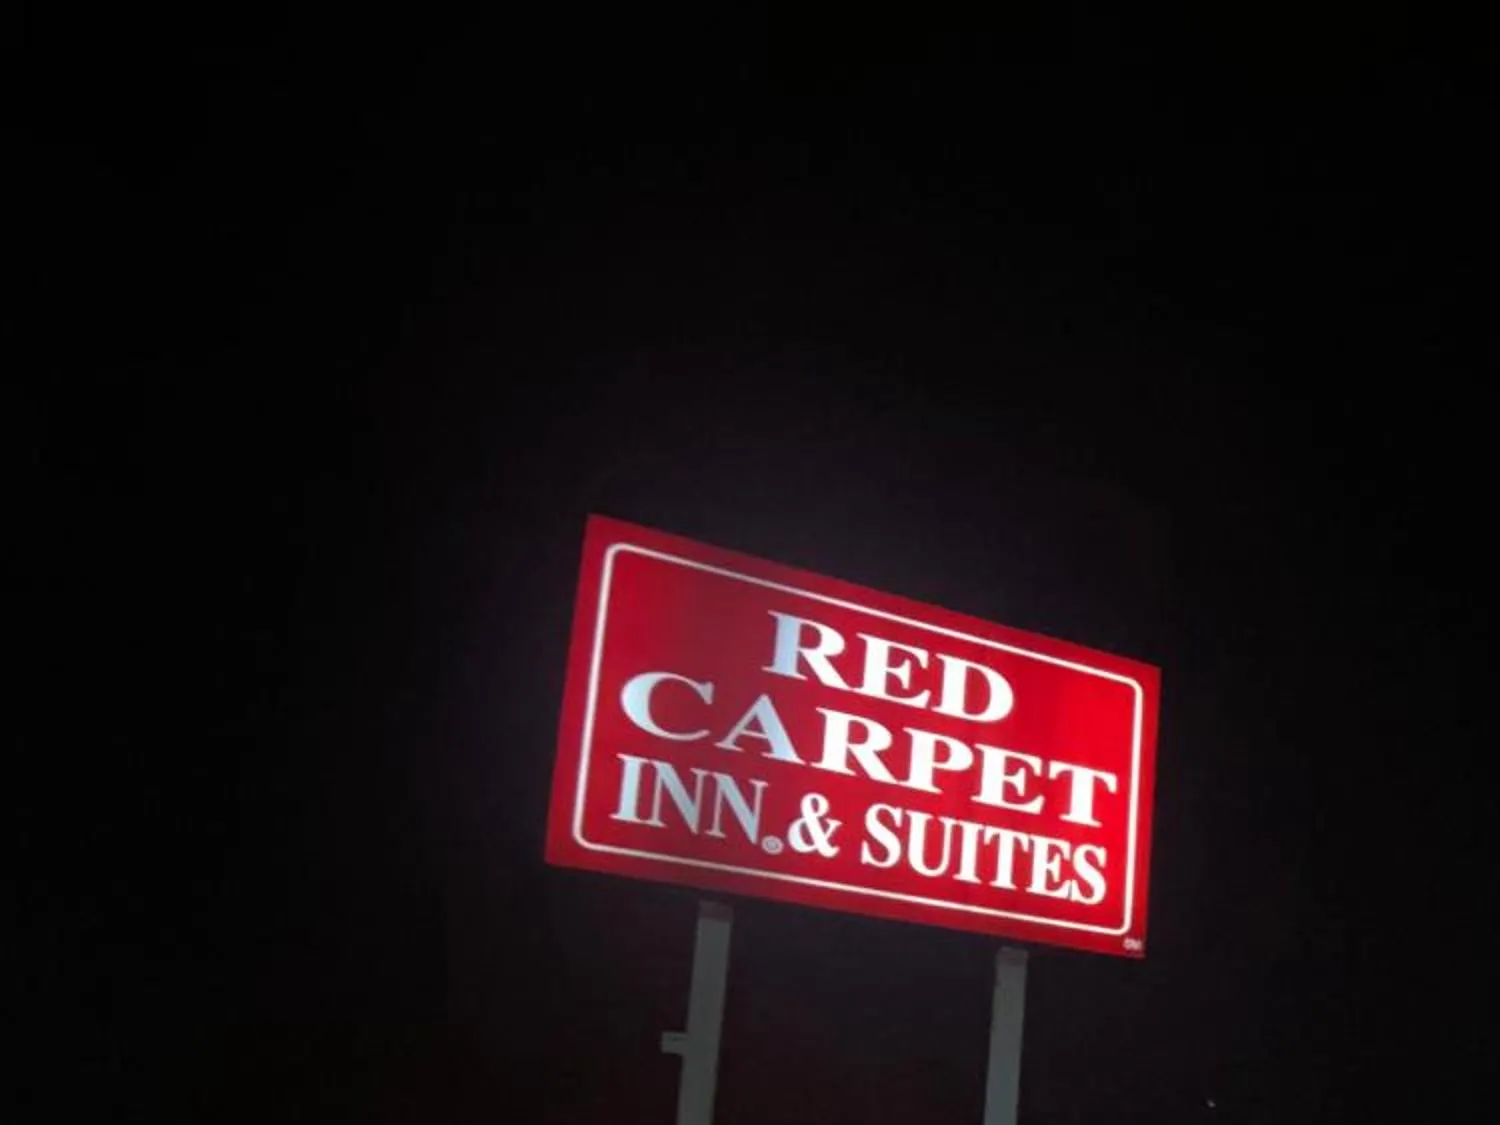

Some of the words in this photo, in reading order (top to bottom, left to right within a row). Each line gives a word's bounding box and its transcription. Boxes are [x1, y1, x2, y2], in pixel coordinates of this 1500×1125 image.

[763, 610, 1014, 723] RED
[620, 671, 1118, 827] CARPET
[787, 792, 843, 858] &
[860, 802, 1108, 906] SUITES
